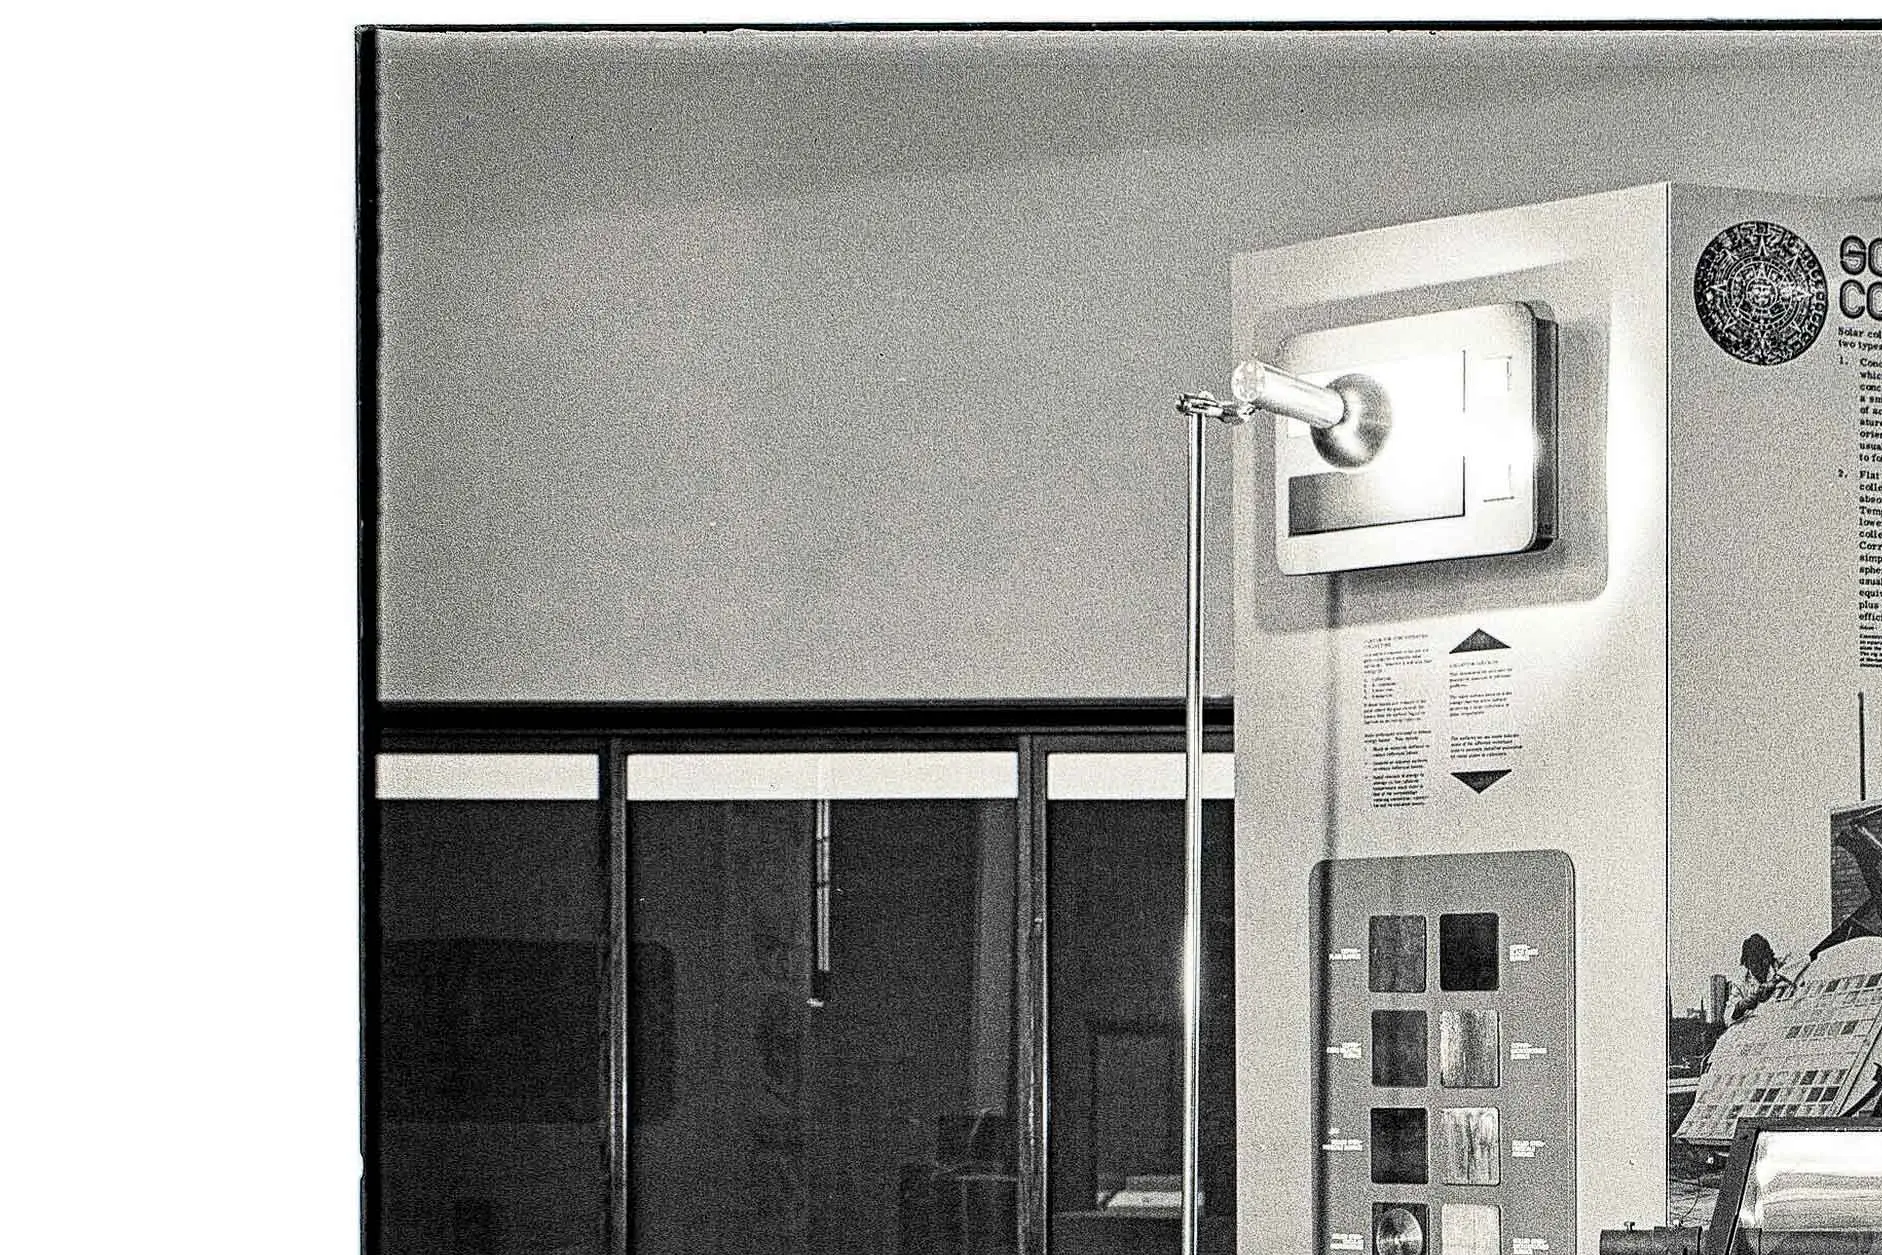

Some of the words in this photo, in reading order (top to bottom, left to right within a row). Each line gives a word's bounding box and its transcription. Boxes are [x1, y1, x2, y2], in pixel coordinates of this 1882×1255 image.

[1838, 327, 1863, 337] Solar
[1839, 339, 1855, 348] two
[1839, 356, 1848, 365] 1.
[1860, 407, 1869, 415] of
[1859, 453, 1869, 461] to
[1860, 470, 1879, 479] Flat
[1859, 601, 1879, 611] plus
